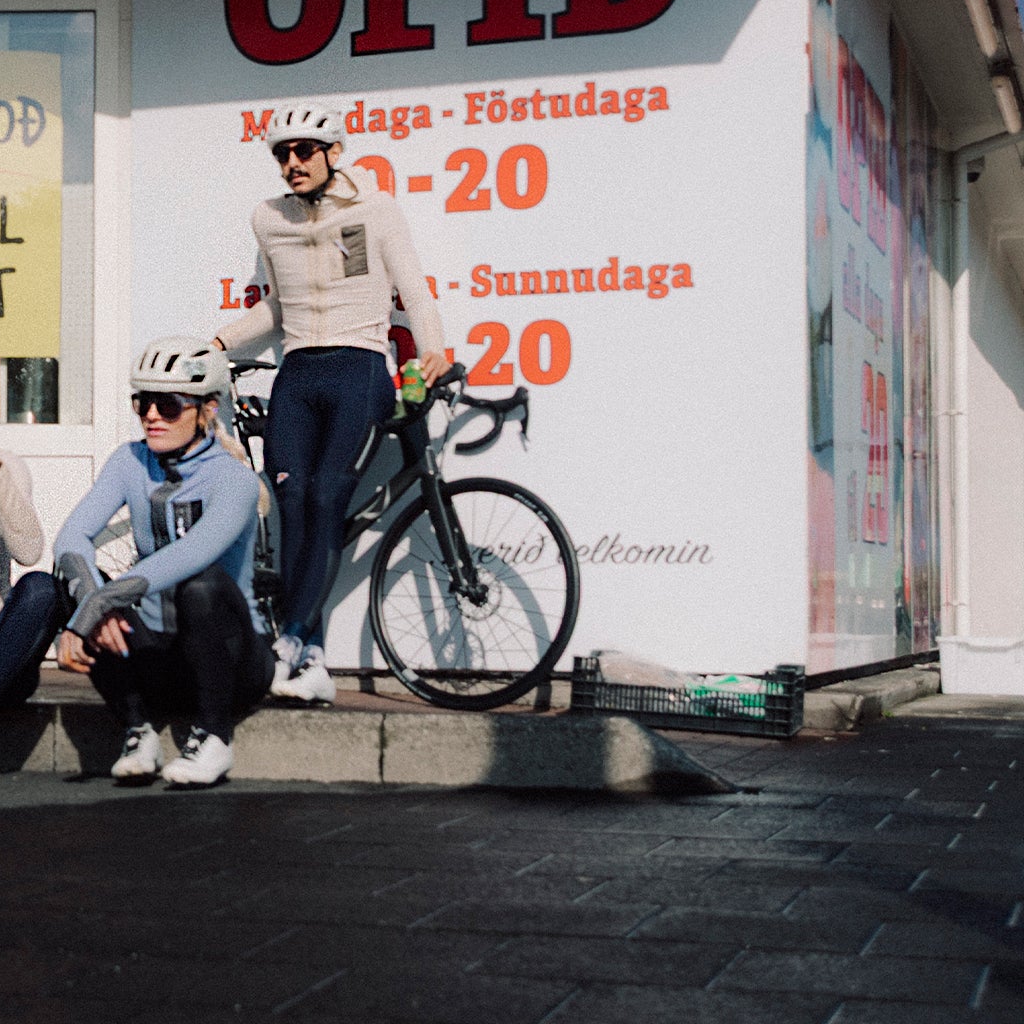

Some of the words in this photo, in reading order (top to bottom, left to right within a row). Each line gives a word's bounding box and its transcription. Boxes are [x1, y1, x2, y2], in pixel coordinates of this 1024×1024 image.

[240, 100, 433, 143] Mdaga
[464, 81, 669, 125] Föstudaga
[470, 256, 694, 299] Sunnudaga
[471, 532, 547, 566] erið
